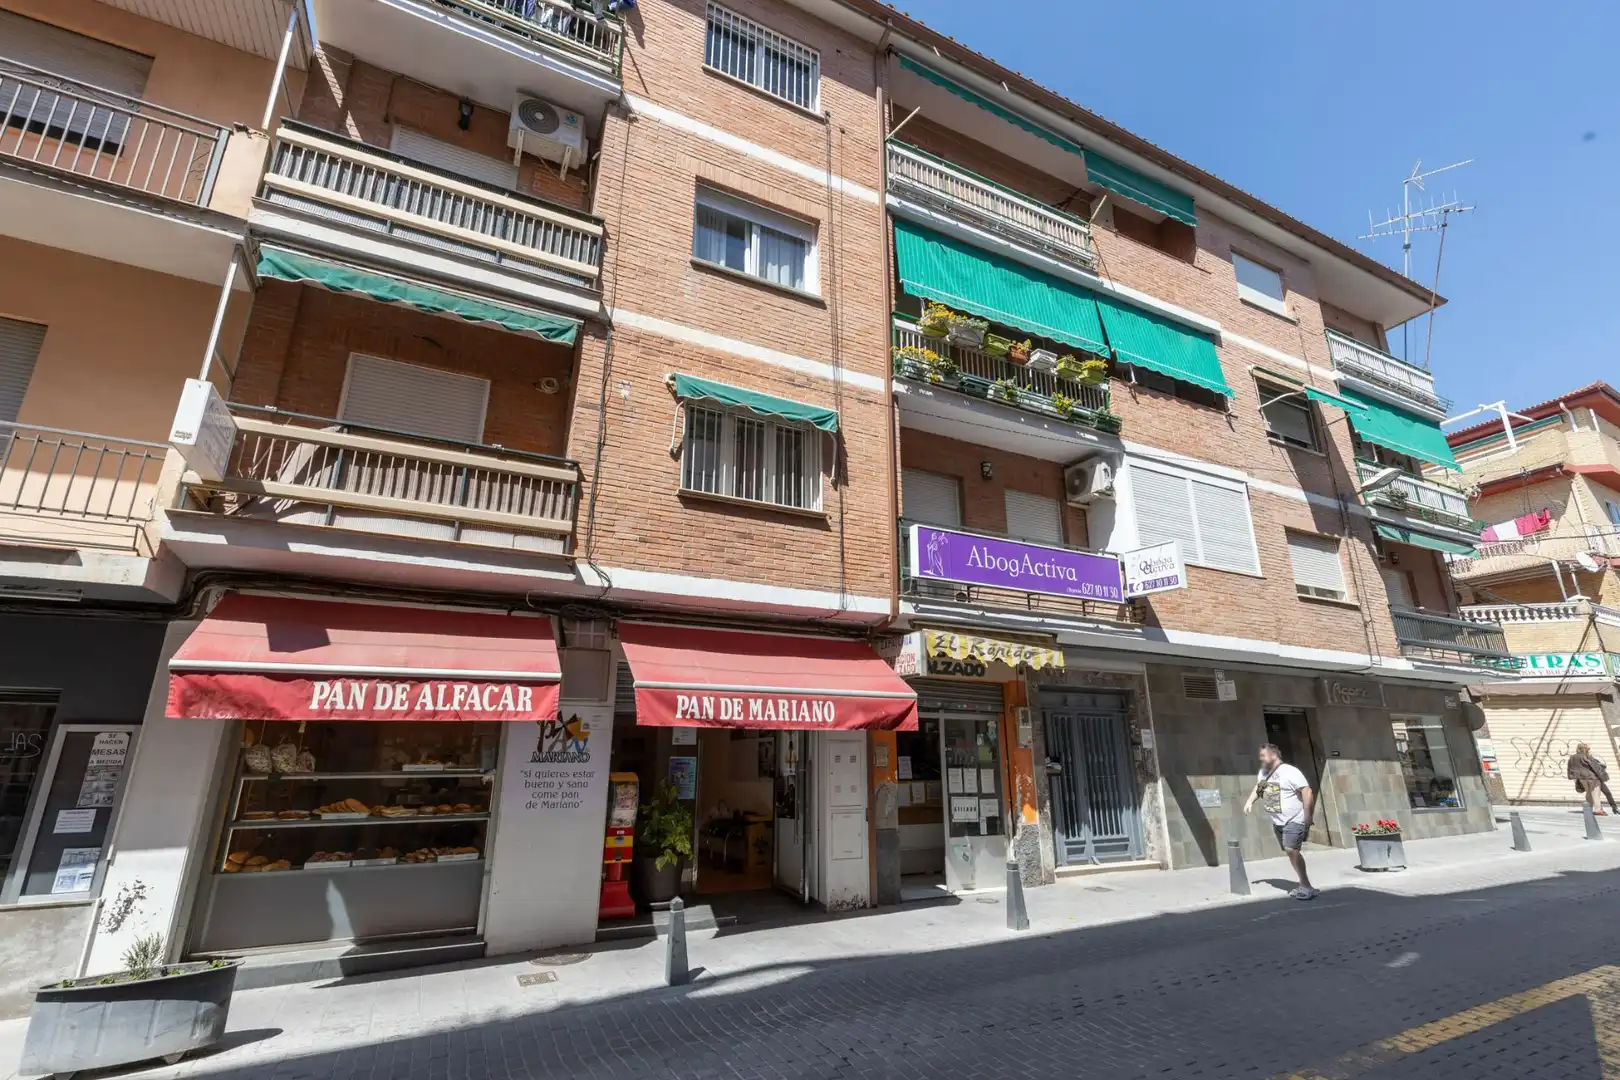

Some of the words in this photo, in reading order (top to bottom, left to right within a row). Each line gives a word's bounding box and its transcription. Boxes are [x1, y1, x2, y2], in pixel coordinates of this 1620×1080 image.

[965, 544, 1078, 582] AbogActiva
[1081, 582, 1094, 596] 627
[1095, 584, 1103, 597] 10
[1103, 586, 1109, 598] 11
[1110, 587, 1118, 599] 30
[308, 681, 368, 710] PAN
[373, 682, 412, 711] DE
[414, 683, 533, 712] ALFACAR
[675, 695, 715, 719] PAN
[719, 697, 744, 721] DE
[748, 698, 836, 723] MARIANO
[91, 748, 126, 756] MESAS
[528, 751, 591, 764] MARIANO
[534, 769, 570, 779] quieres
[572, 770, 596, 779] estar
[524, 779, 555, 789] bueno
[557, 781, 564, 790] y
[566, 780, 589, 788] sano
[531, 791, 559, 799] come
[561, 791, 580, 800] pan
[525, 800, 538, 810] de
